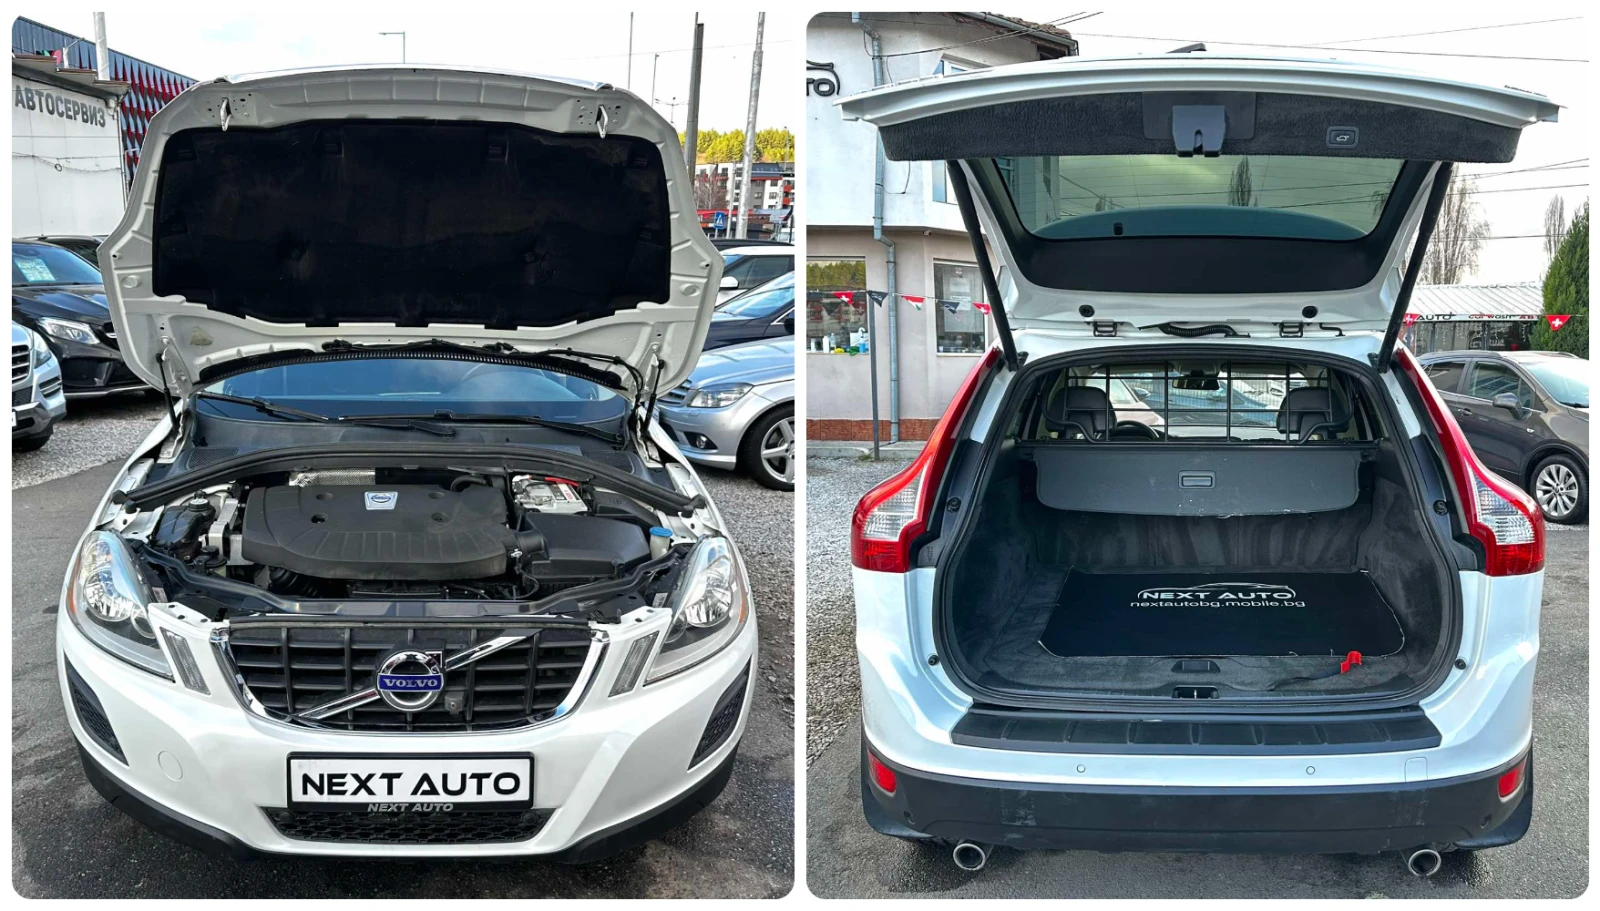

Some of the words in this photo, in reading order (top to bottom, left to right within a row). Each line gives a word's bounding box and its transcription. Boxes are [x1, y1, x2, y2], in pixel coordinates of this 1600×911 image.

[14, 84, 106, 128] АВТОСЕРВИЗ
[1130, 600, 1306, 608] nextautobg.mobile.bg
[383, 678, 438, 688] VOLVO
[302, 772, 404, 796] NEXT
[410, 772, 521, 796] AUTO
[367, 803, 410, 812] NEXT
[411, 803, 454, 812] AUTO
